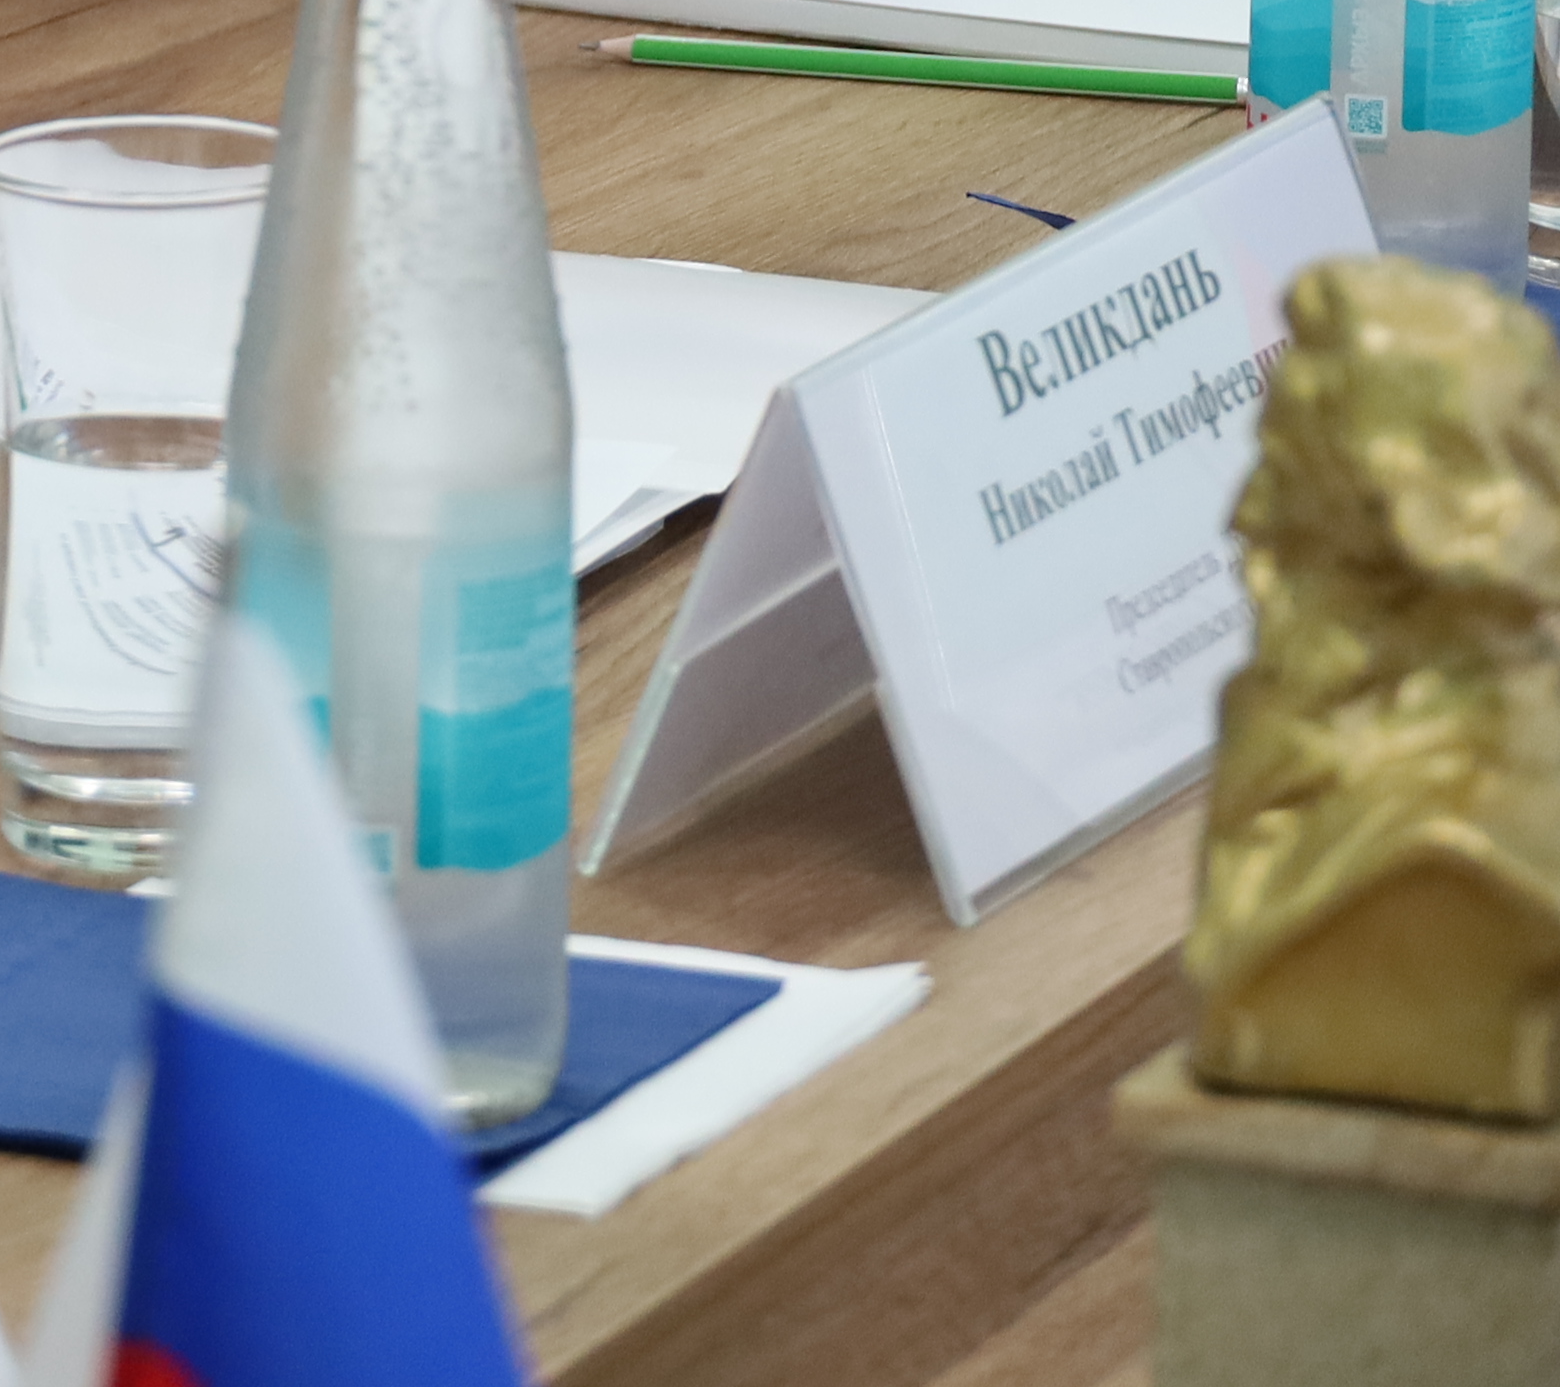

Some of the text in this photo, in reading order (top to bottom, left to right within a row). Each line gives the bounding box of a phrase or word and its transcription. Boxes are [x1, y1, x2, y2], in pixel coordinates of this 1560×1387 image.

[976, 248, 1222, 418] Великдань
[978, 337, 1288, 546] Николай Тимофееви
